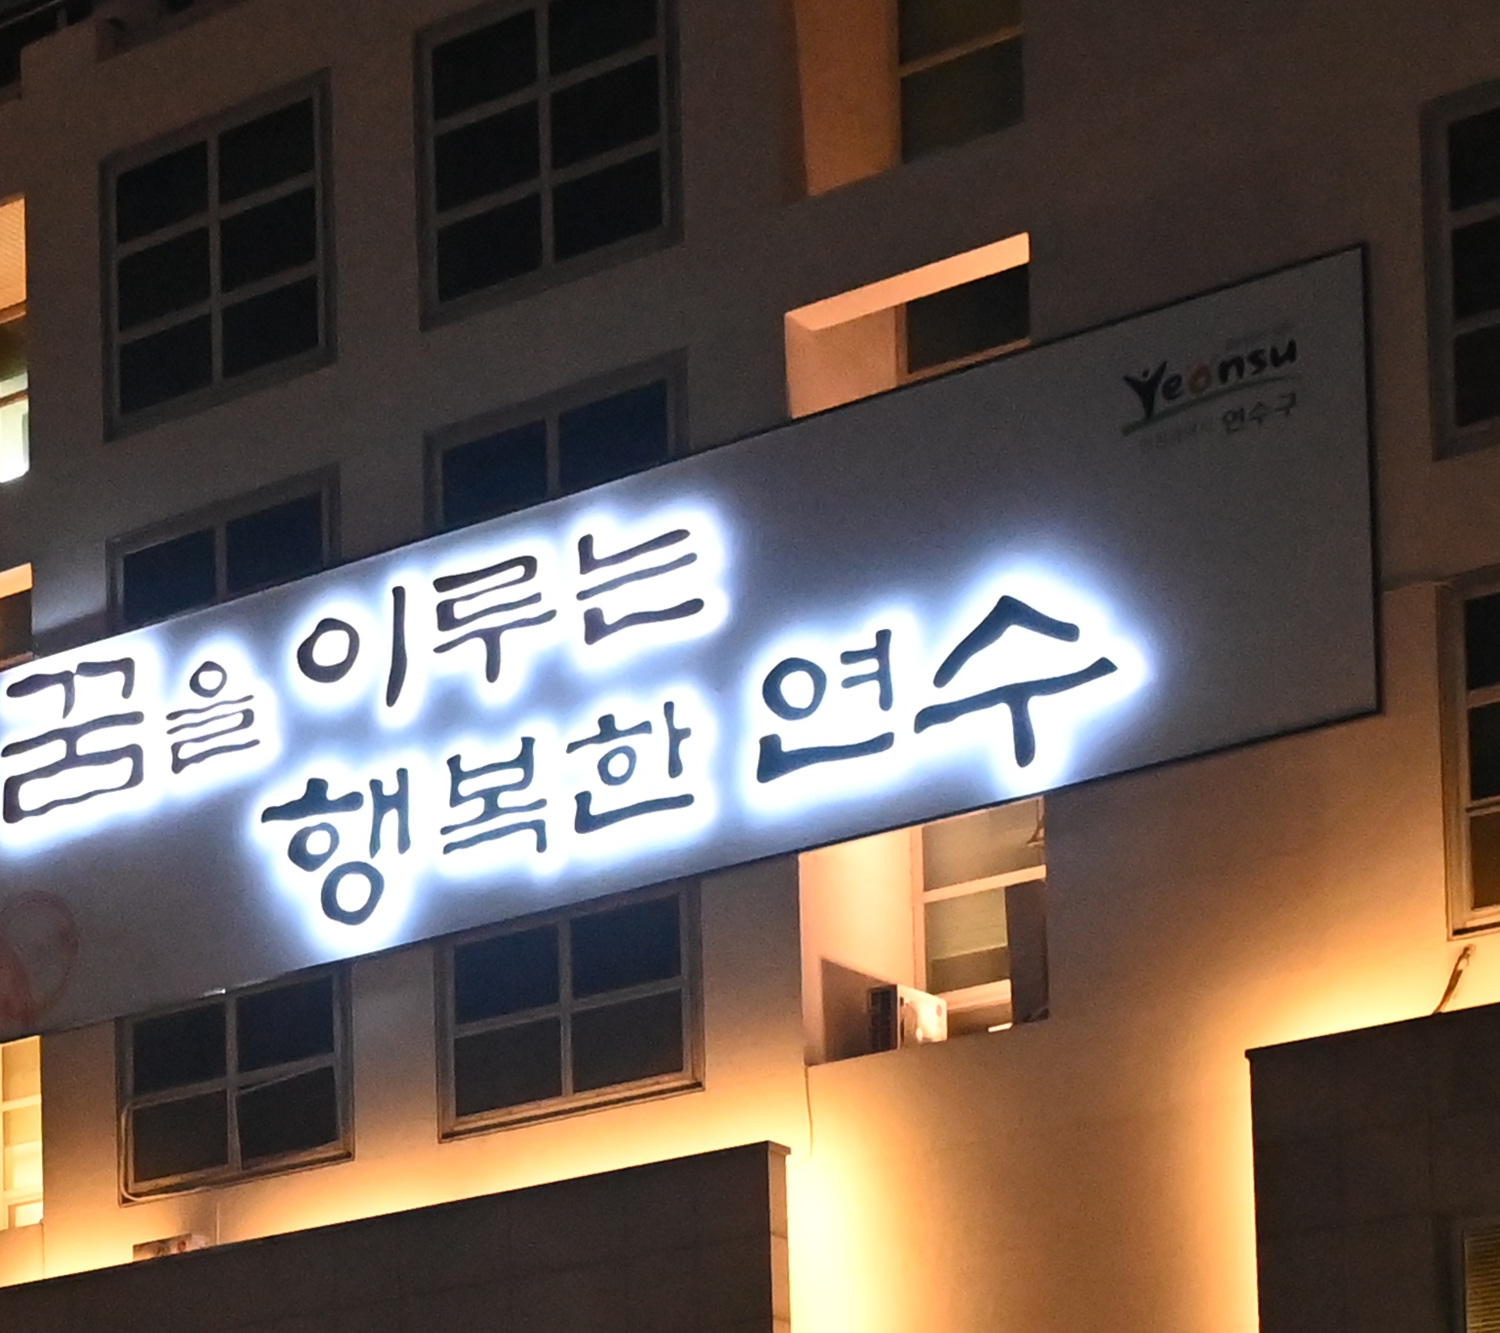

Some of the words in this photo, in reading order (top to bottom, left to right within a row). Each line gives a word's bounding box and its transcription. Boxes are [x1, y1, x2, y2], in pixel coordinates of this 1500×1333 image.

[1122, 338, 1298, 421] Yeonsu
[0, 656, 261, 824] 꿈을
[296, 527, 705, 708] 이루는
[260, 700, 695, 927] 행복한
[755, 593, 1119, 784] 연수
